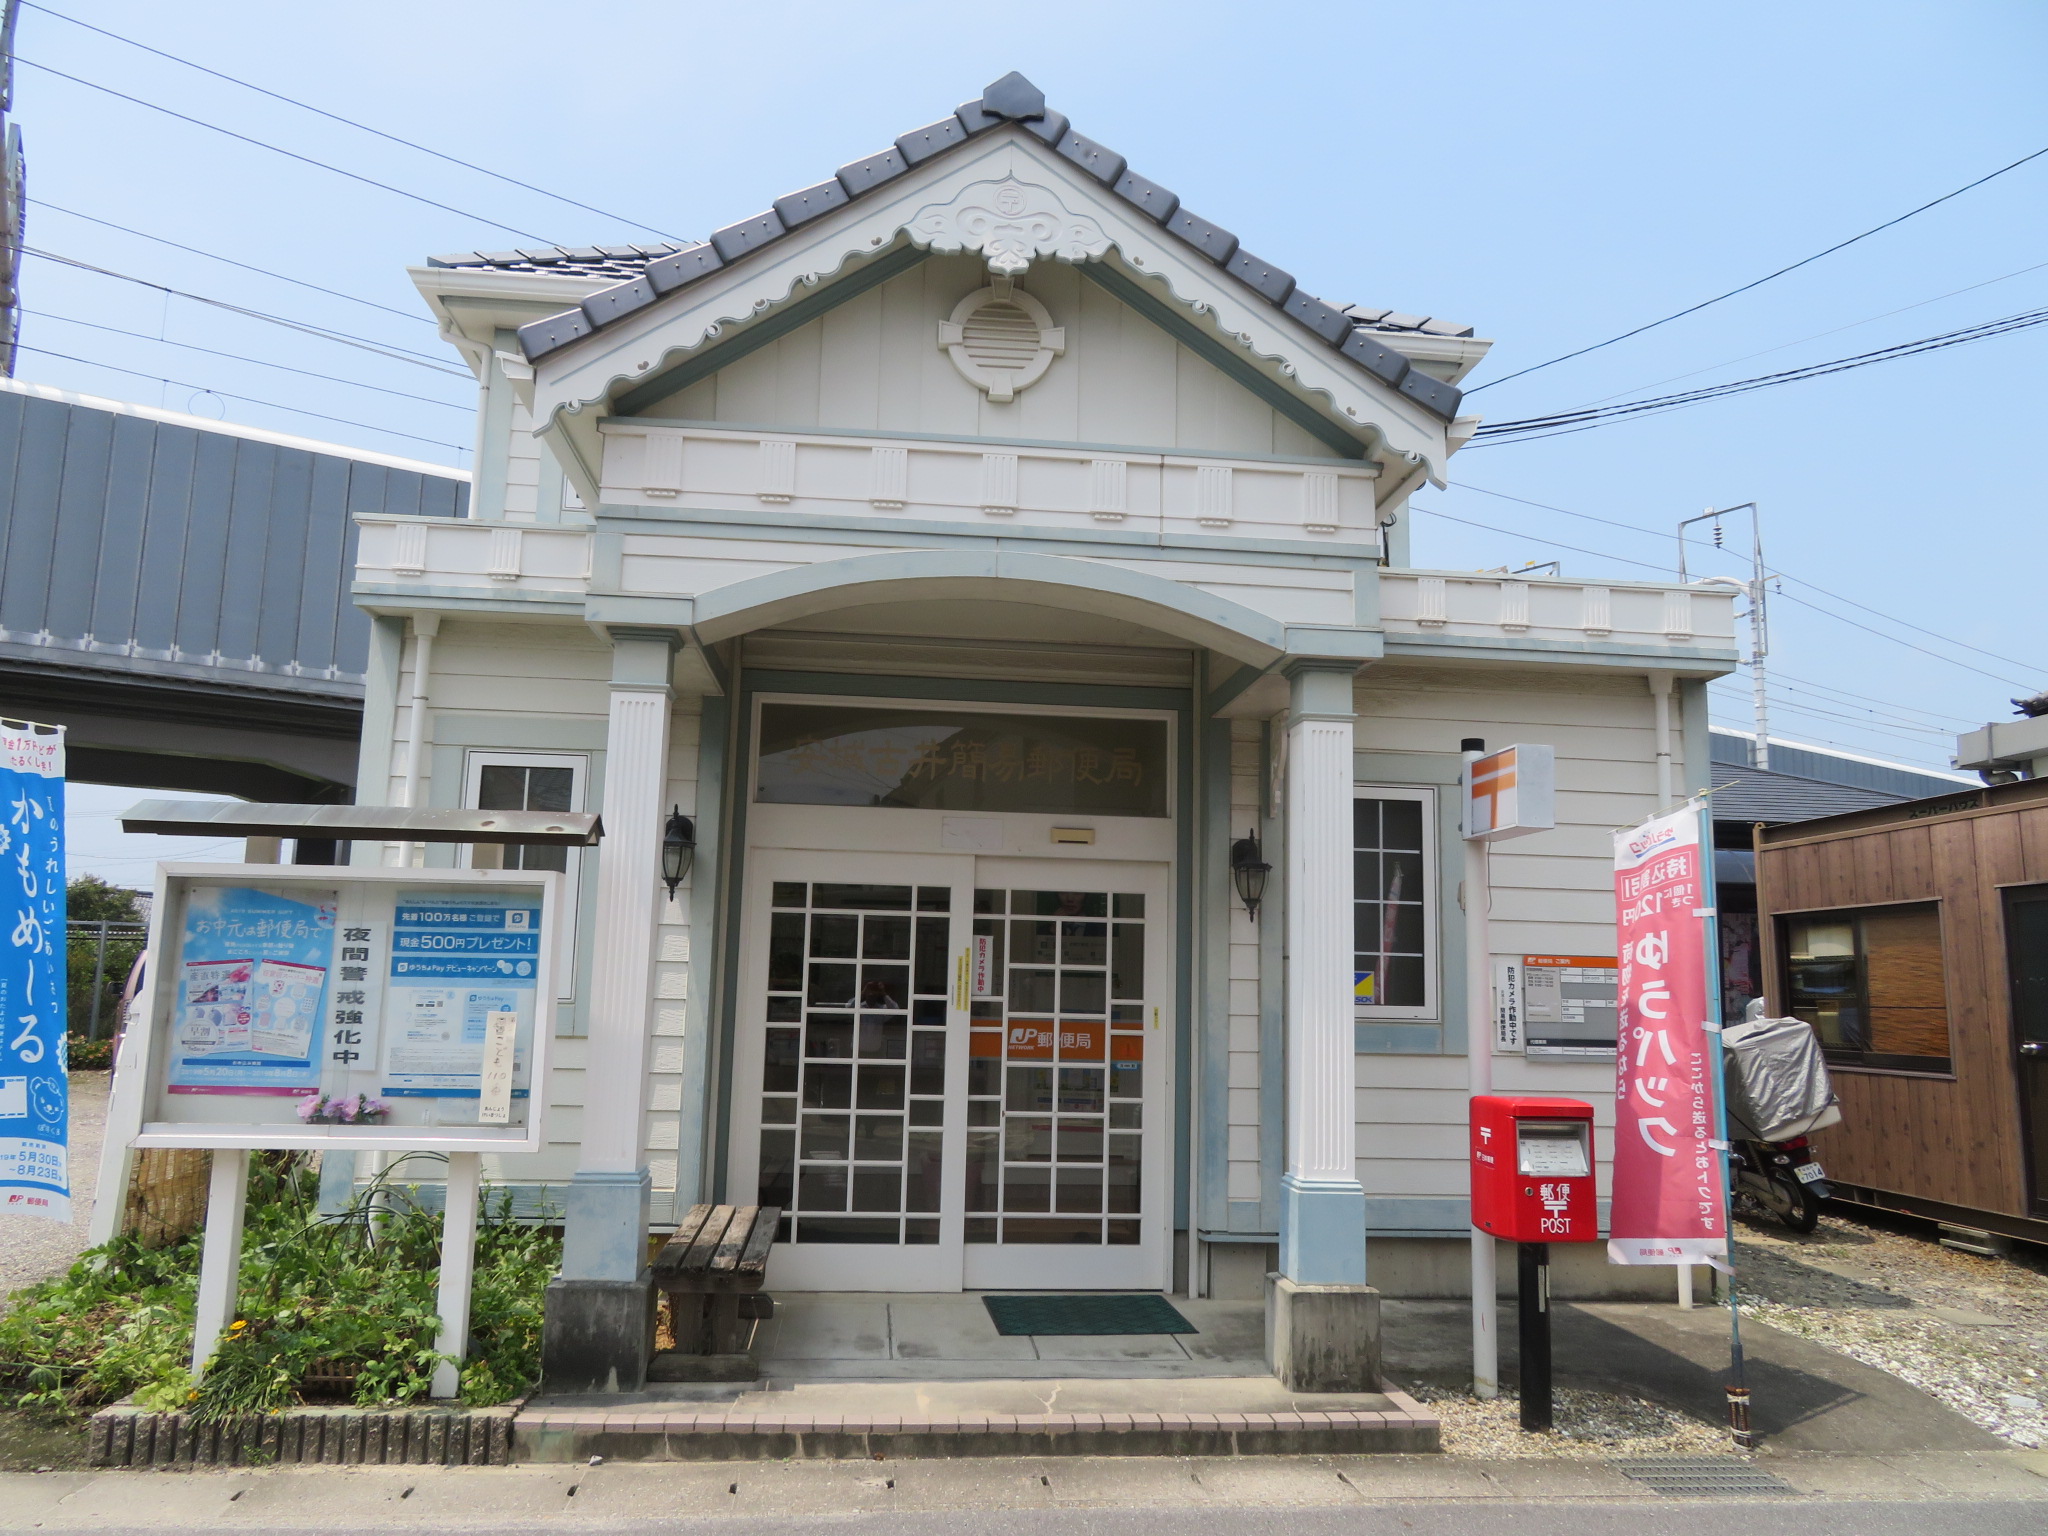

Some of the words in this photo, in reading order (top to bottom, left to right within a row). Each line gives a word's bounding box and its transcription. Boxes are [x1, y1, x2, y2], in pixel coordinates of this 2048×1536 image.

[10, 787, 44, 1064] かもめーる
[196, 918, 323, 940] お中元は郵便局で
[400, 935, 532, 951] 現金500円プレゼント!
[332, 927, 373, 1065] 夜間警戒強化中
[1507, 966, 1518, 1046] 防犯カメラ作動中です
[1009, 1028, 1038, 1044] JP
[1037, 1032, 1091, 1049] 郵便局
[1539, 1183, 1571, 1202] 郵便
[1541, 1217, 1572, 1234] POST
